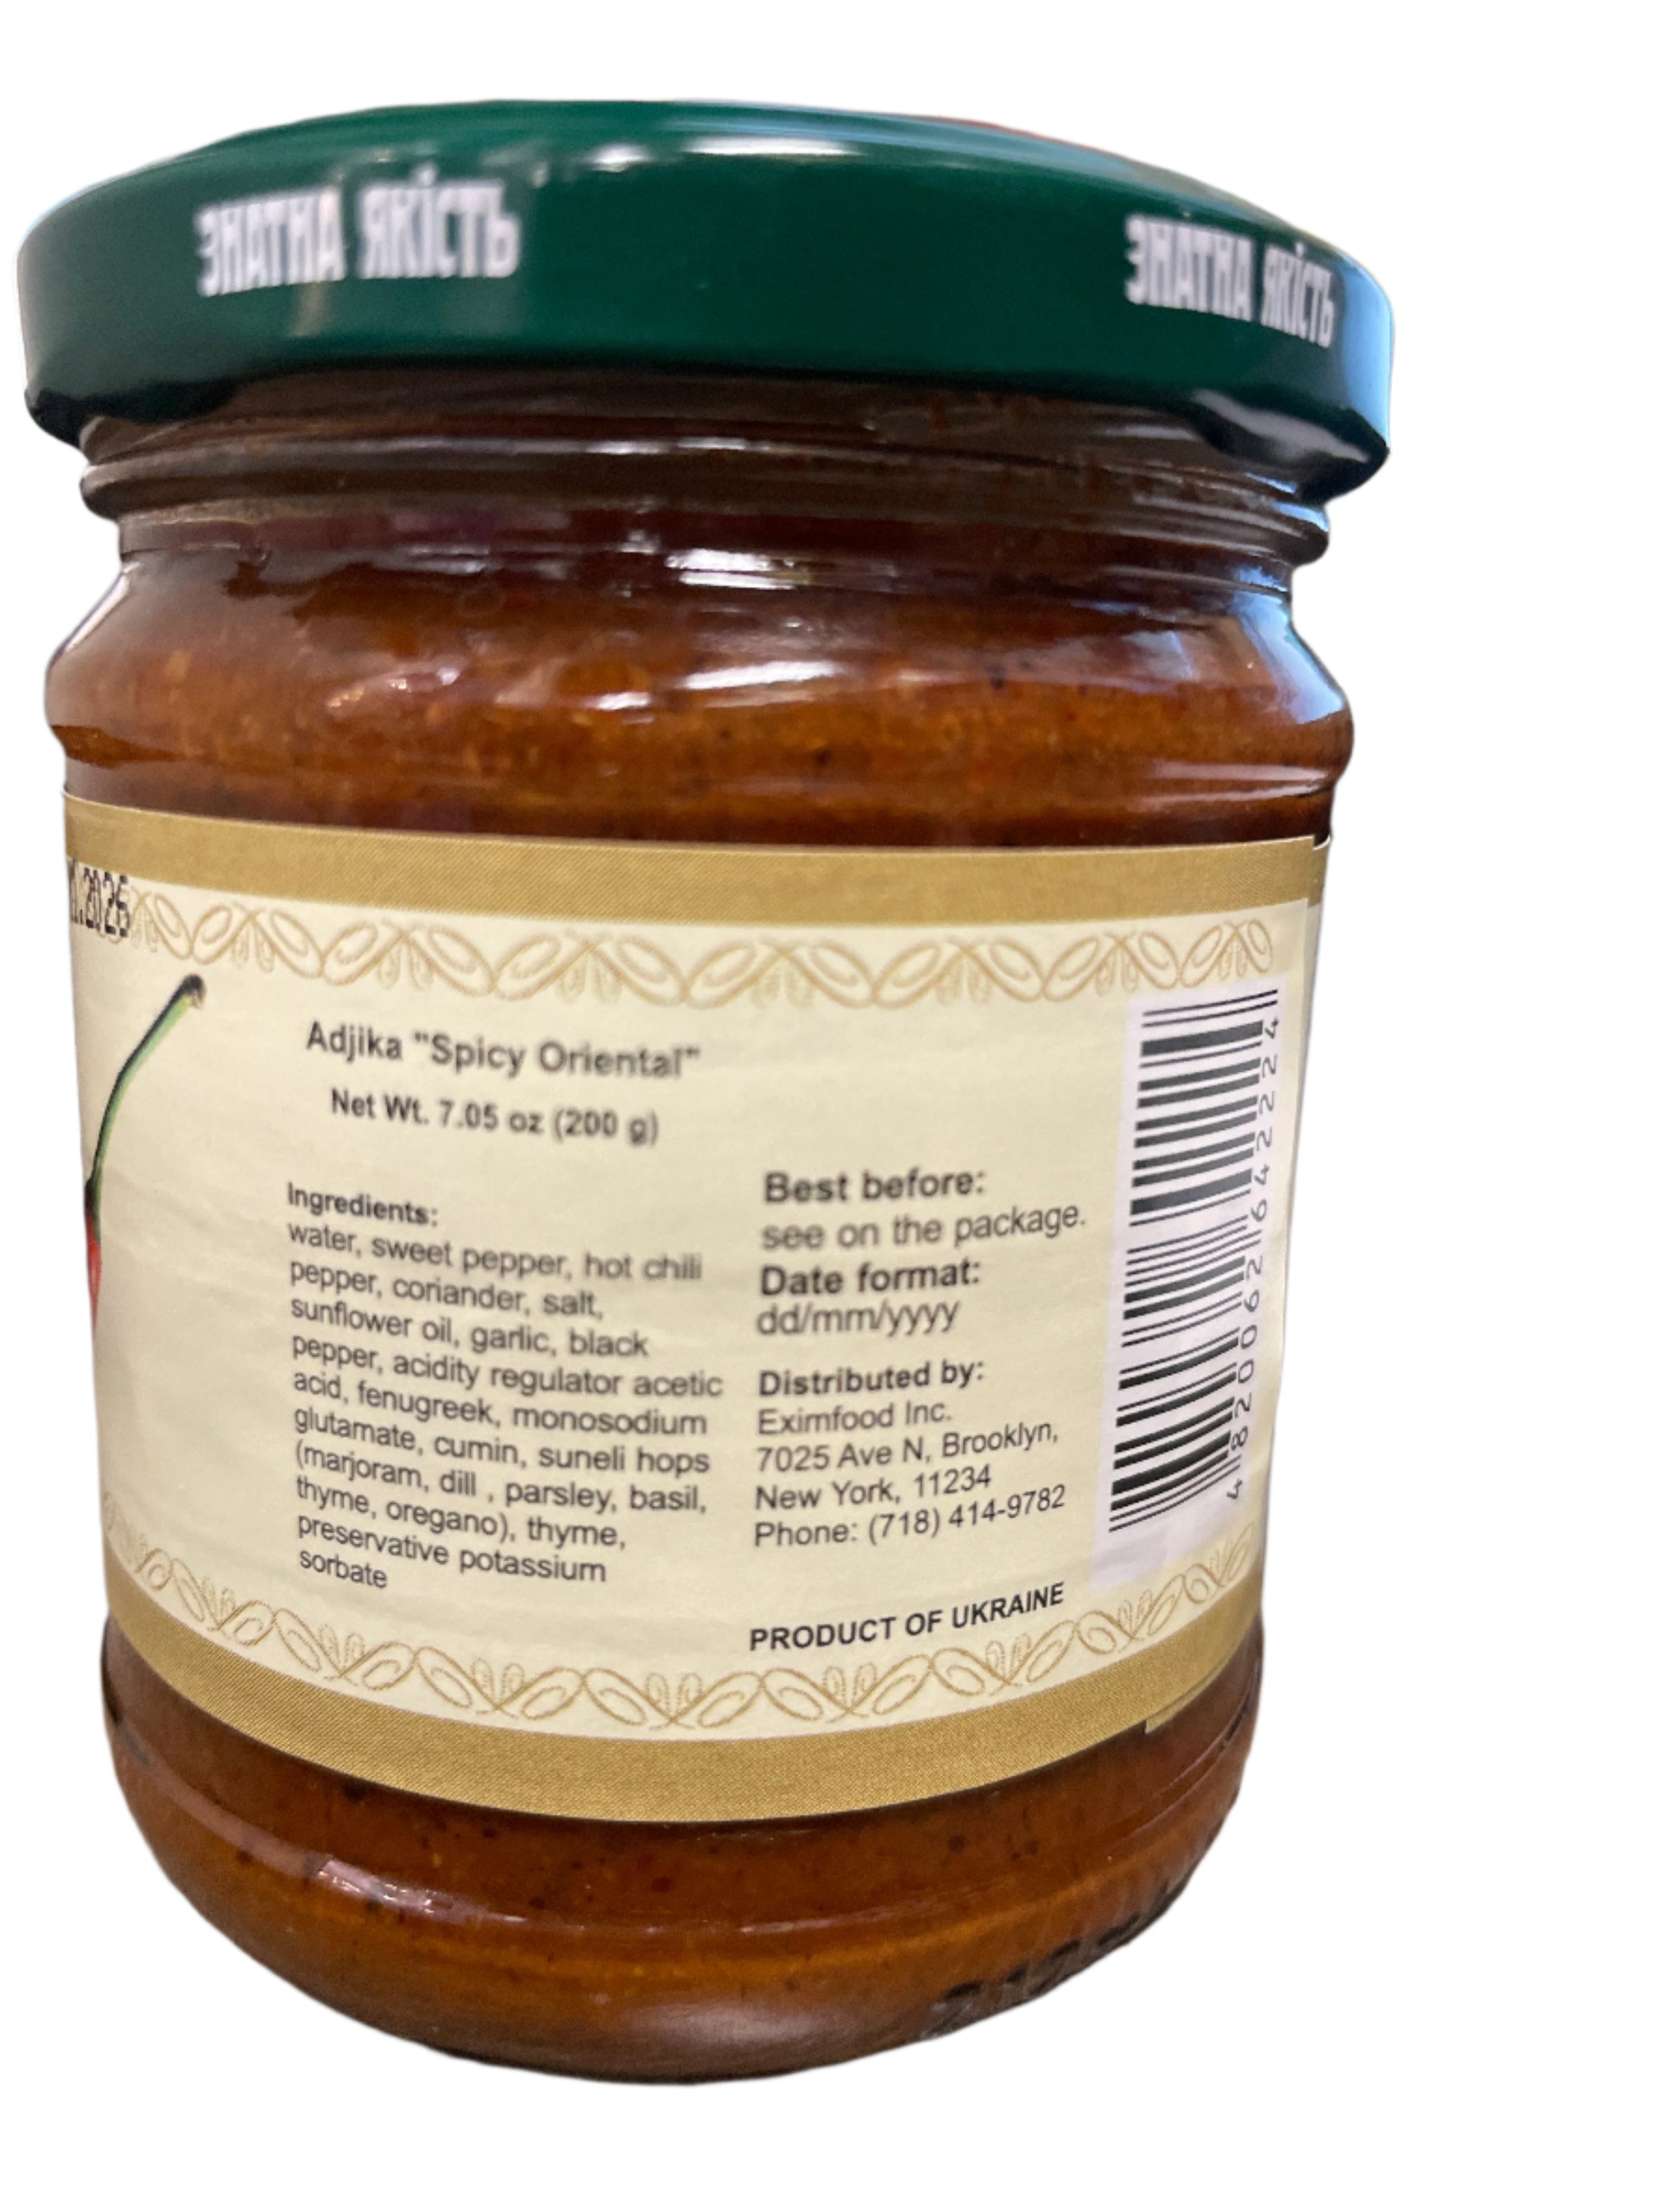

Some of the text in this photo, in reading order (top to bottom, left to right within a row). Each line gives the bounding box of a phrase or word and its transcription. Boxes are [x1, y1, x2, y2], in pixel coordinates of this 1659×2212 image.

[307, 1021, 700, 1078] Adjika "Spicy Oriental"
[332, 1088, 659, 1146] Net Wt. 7.05 oz (200 g)
[287, 1183, 438, 1227] Ingredients:
[765, 1168, 985, 1202] Best before:
[288, 1223, 702, 1281] water, sweet pepper, hot chili
[762, 1205, 1085, 1249] see on the package.
[291, 1261, 602, 1318] pepper, coriander, salt,
[762, 1258, 981, 1295] Date format:
[291, 1300, 649, 1356] sunflower oil, garlic, black
[757, 1300, 959, 1337] dd/mm/yyyy
[292, 1335, 723, 1396] pepper, acidity regulator acetic
[760, 1360, 984, 1396] Distributed by:
[294, 1371, 707, 1435] acid, fenugreek, monosodium
[757, 1402, 951, 1434] Eximfood Inc.
[295, 1407, 709, 1478] glutamate, cumin, suneli hops
[756, 1422, 1058, 1472] 7025 Ave N, Brooklyn,
[295, 1440, 429, 1493] (marjoram,
[506, 1481, 617, 1513] parsley,
[630, 1485, 706, 1512] basil,
[755, 1464, 991, 1510] New York, 11234
[297, 1477, 626, 1550] thyme, oregano), thyme,
[754, 1484, 1065, 1547] Phone: (718) 414-9782
[299, 1515, 606, 1582] preservative potassium
[300, 1550, 387, 1588] sorbate
[750, 1582, 1065, 1651] PRODUCT OF UKRAINE
